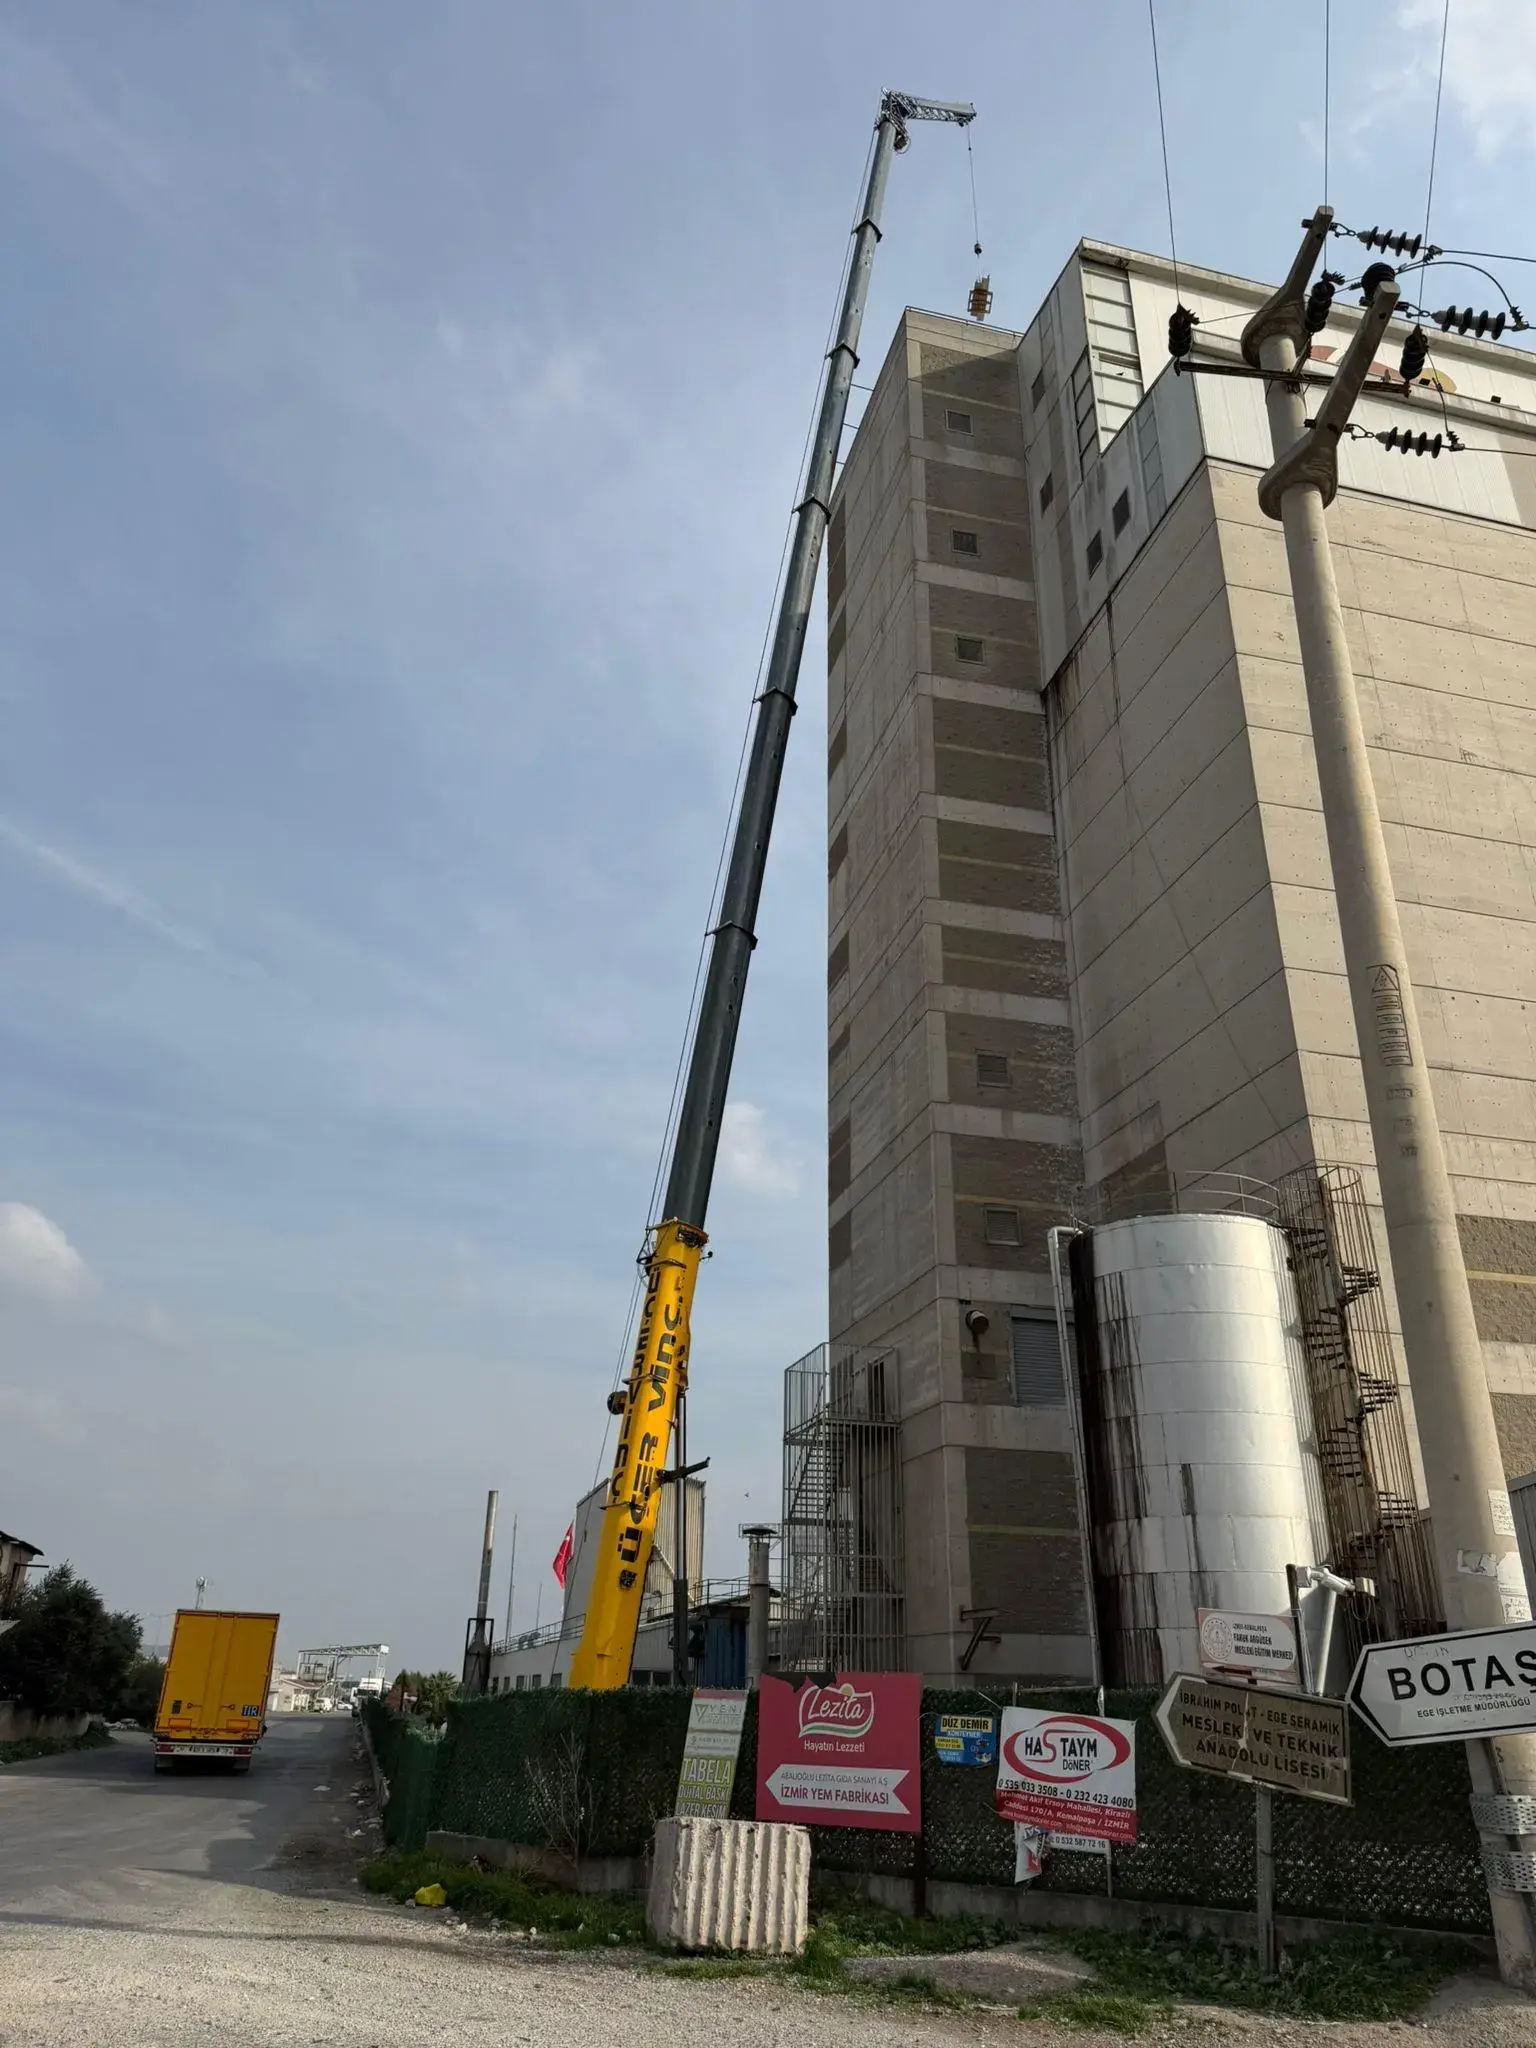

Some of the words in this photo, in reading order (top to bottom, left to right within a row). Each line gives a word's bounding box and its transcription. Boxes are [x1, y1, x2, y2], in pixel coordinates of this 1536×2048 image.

[1233, 1633, 1250, 1643] FARUK
[1387, 1650, 1536, 1701] BOTAŞ
[243, 1705, 258, 1716] TIR
[807, 1688, 865, 1720] Lezita
[1417, 1710, 1435, 1718] EGE
[1436, 1705, 1473, 1718] İŞLETME
[1474, 1698, 1531, 1712] MÜDÜRLÜĞÜ
[960, 1716, 989, 1730] DEMİR
[1224, 1702, 1257, 1718] POLAT
[1267, 1710, 1287, 1725] EGE
[1290, 1714, 1340, 1735] SERAMİK
[1182, 1713, 1246, 1738] MESLEK
[1253, 1728, 1272, 1745] VE
[1277, 1732, 1338, 1758] TEKNİK
[804, 1740, 834, 1753] Hayatın
[835, 1741, 865, 1753] Lezzeti
[1196, 1739, 1269, 1766] ANADOLU
[1274, 1754, 1326, 1780] LİSESİ
[681, 1758, 732, 1784] TABELA
[836, 1775, 852, 1784] GIDA
[780, 1784, 808, 1799] İZMİR
[810, 1788, 833, 1801] YEM
[835, 1788, 889, 1805] FABRİKASI
[1005, 1780, 1019, 1790] 535
[1022, 1780, 1035, 1792] 033
[1038, 1784, 1058, 1797] 3508
[1066, 1788, 1072, 1798] 0
[1074, 1790, 1090, 1802] 232
[1092, 1792, 1108, 1804] 423
[1111, 1796, 1134, 1808] 4080
[1029, 1796, 1044, 1804] Akif
[1044, 1798, 1065, 1810] Ersoy
[675, 1802, 700, 1817] LAZER
[1056, 1811, 1096, 1825] Kemalpaşa
[1104, 1817, 1130, 1830] İZMİR
[1055, 1836, 1060, 1844] 0
[1074, 1838, 1086, 1846] 587
[1088, 1838, 1096, 1848] 72
